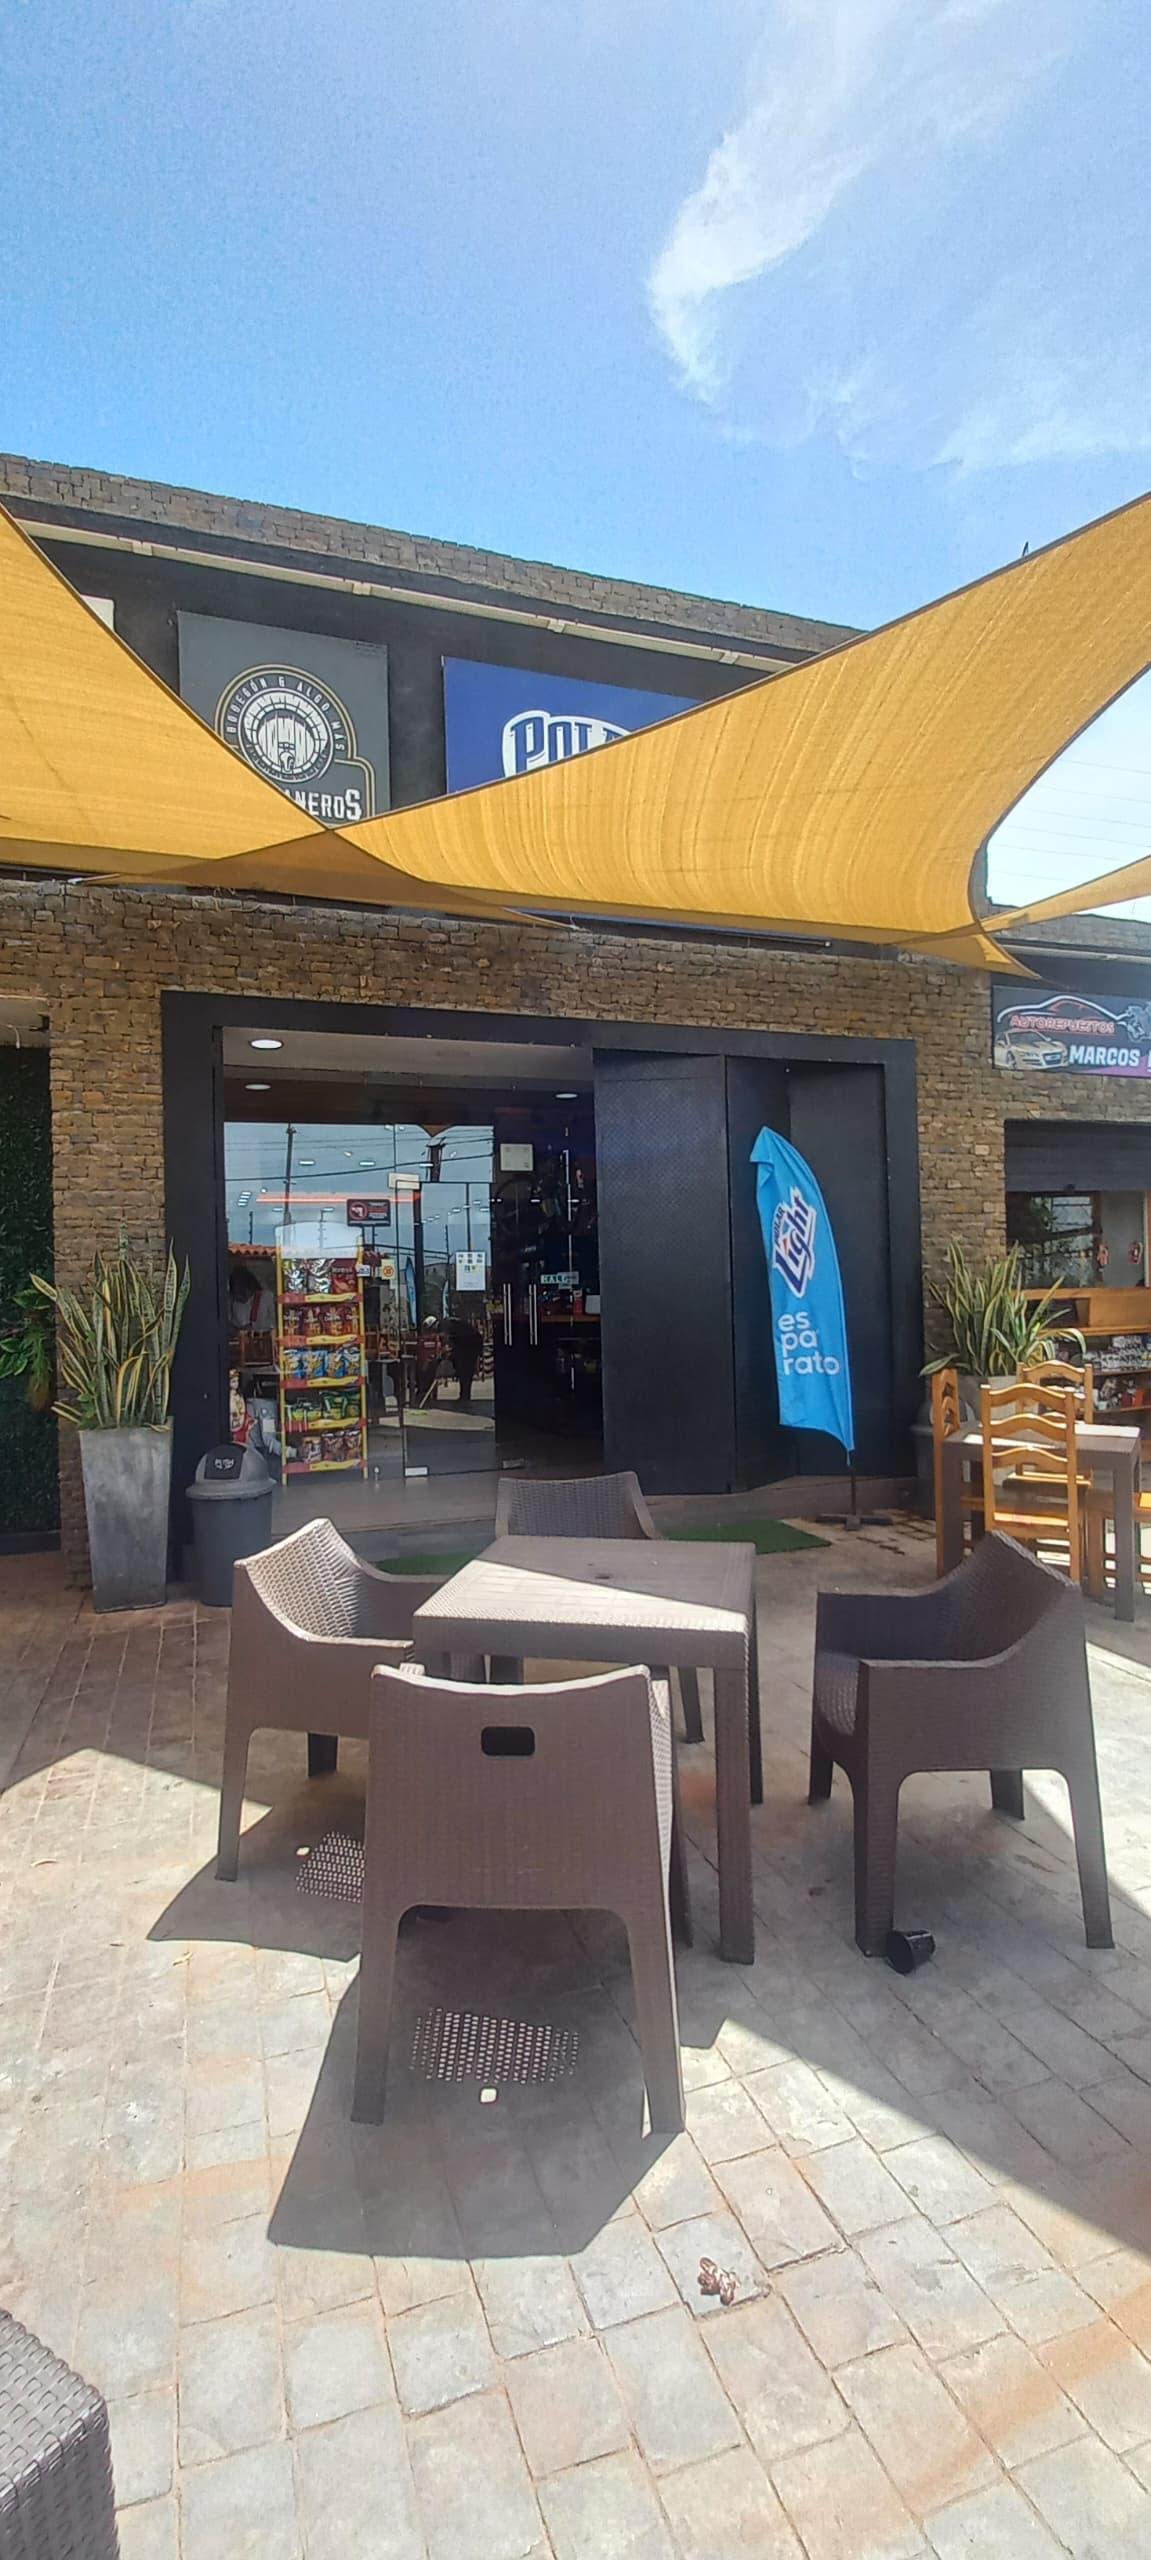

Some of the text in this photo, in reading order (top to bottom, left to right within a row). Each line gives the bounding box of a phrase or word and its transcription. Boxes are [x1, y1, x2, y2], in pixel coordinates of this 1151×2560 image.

[226, 677, 268, 733] BODEGÓN
[297, 681, 330, 712] ALGO
[510, 716, 627, 774] POL
[1069, 1044, 1141, 1067] MARCOS
[778, 1311, 810, 1331] es
[783, 1351, 840, 1375] rato
